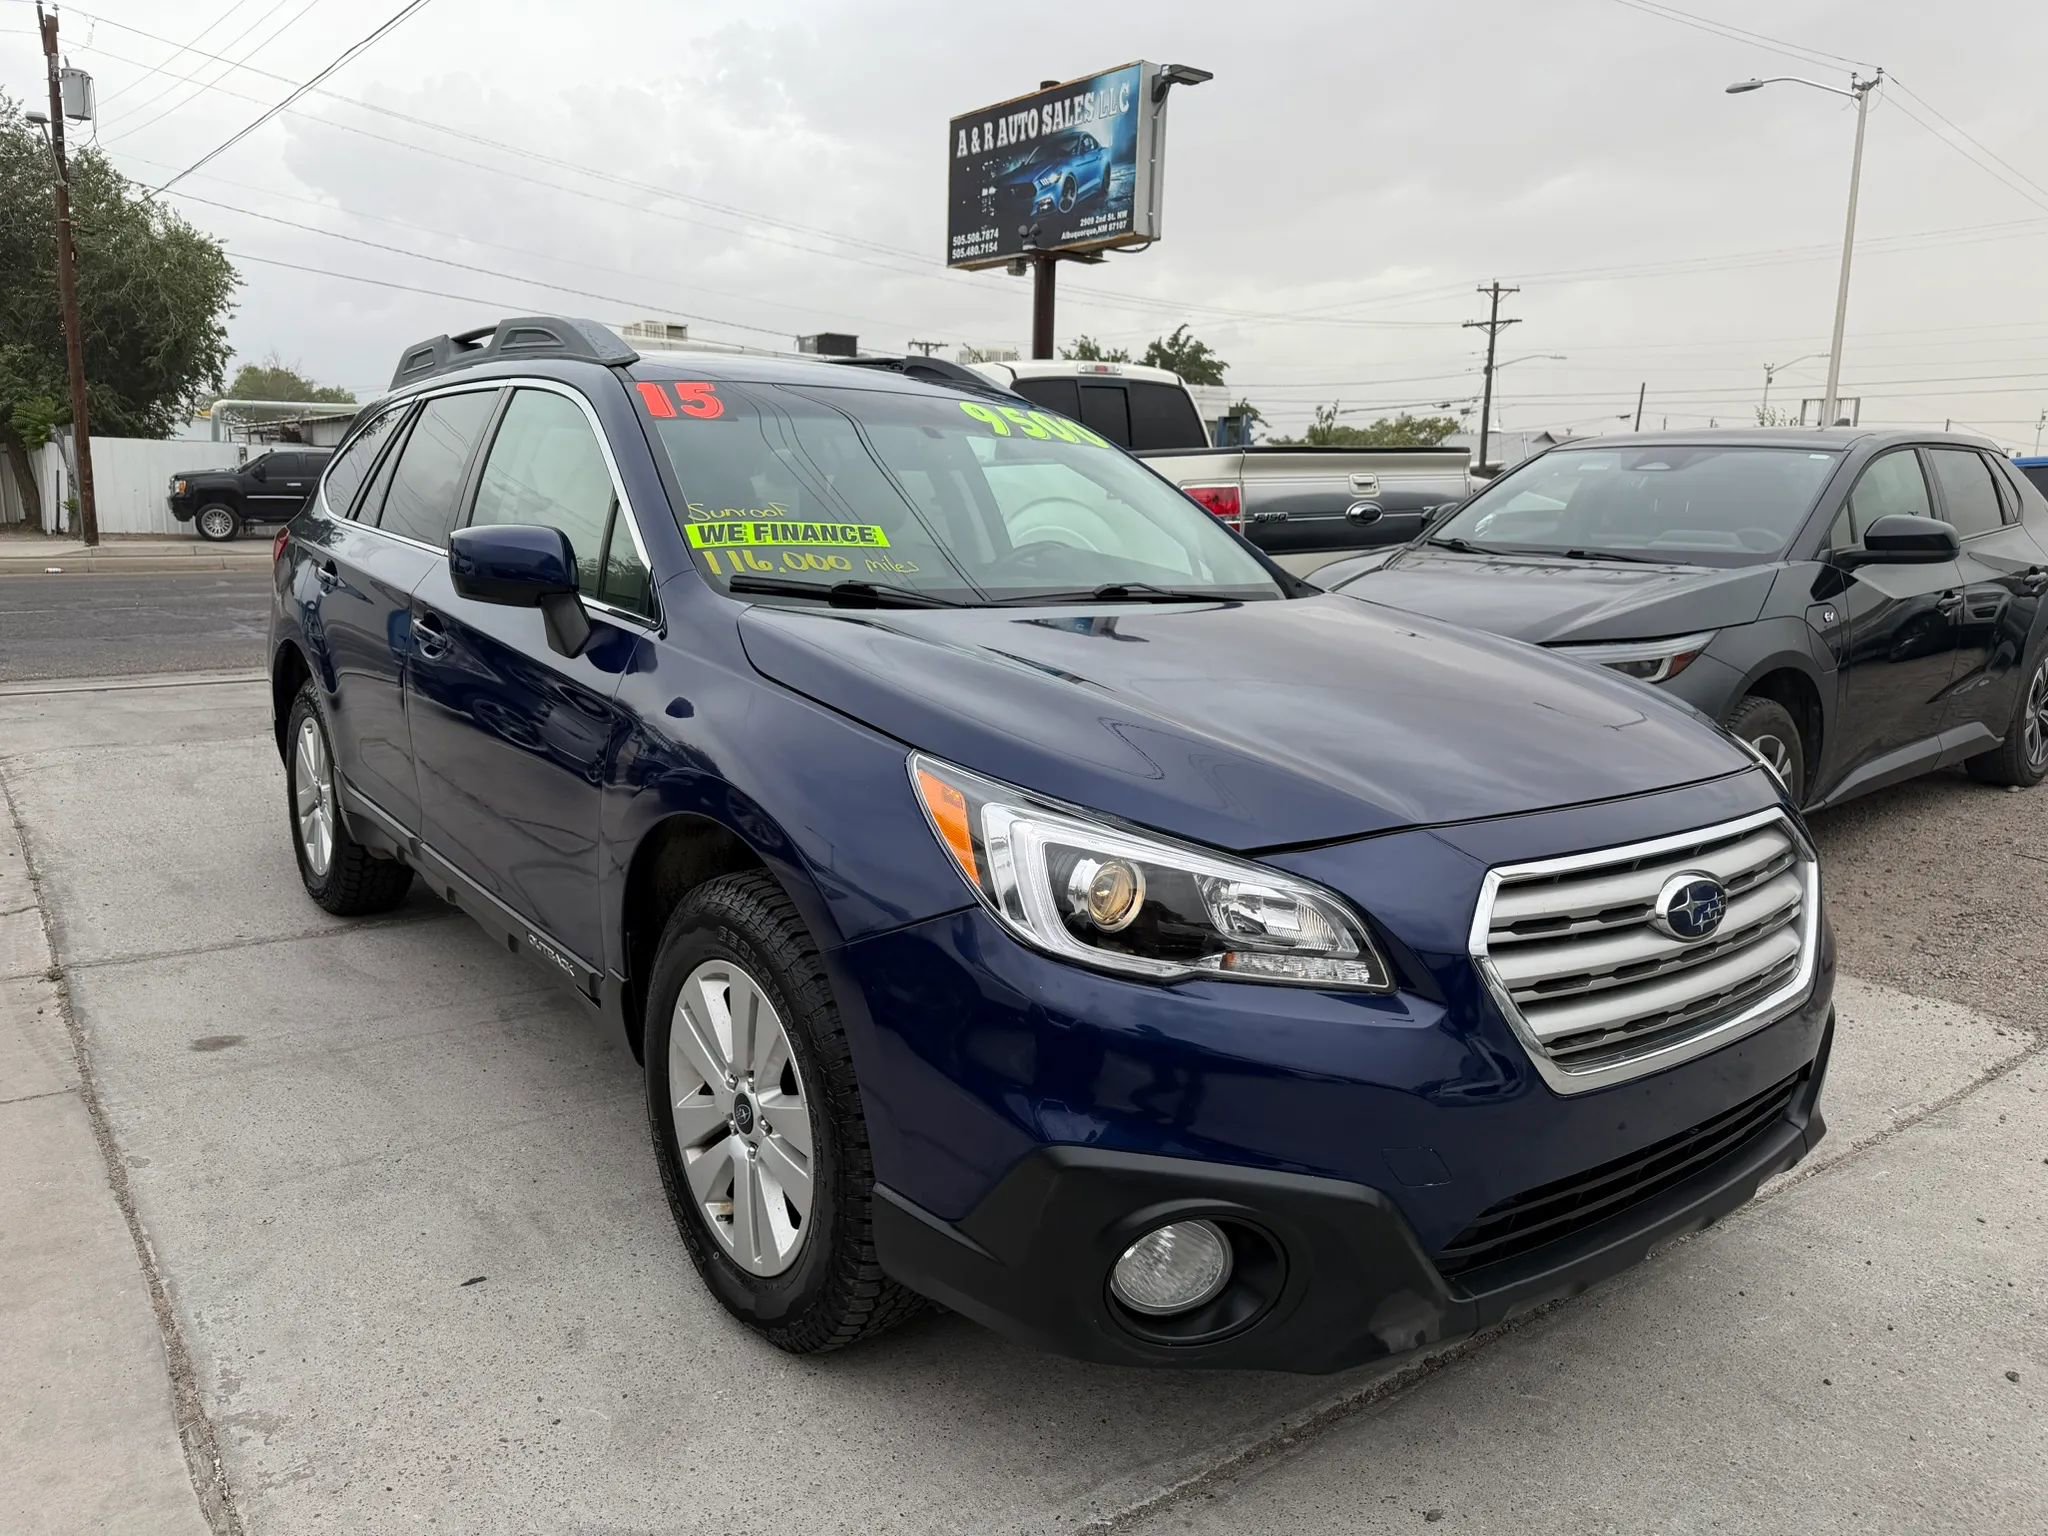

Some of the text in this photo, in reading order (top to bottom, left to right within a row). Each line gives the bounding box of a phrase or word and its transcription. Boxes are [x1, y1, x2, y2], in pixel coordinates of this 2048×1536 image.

[957, 82, 1129, 158] A & R AUTO SALES LLC
[1095, 214, 1107, 224] 2nd
[1117, 210, 1128, 219] NW
[1109, 220, 1127, 231] 87107
[636, 382, 725, 419] 15
[959, 401, 1110, 449] 9500
[697, 523, 880, 546] WE FINANCE
[864, 554, 919, 574] miles
